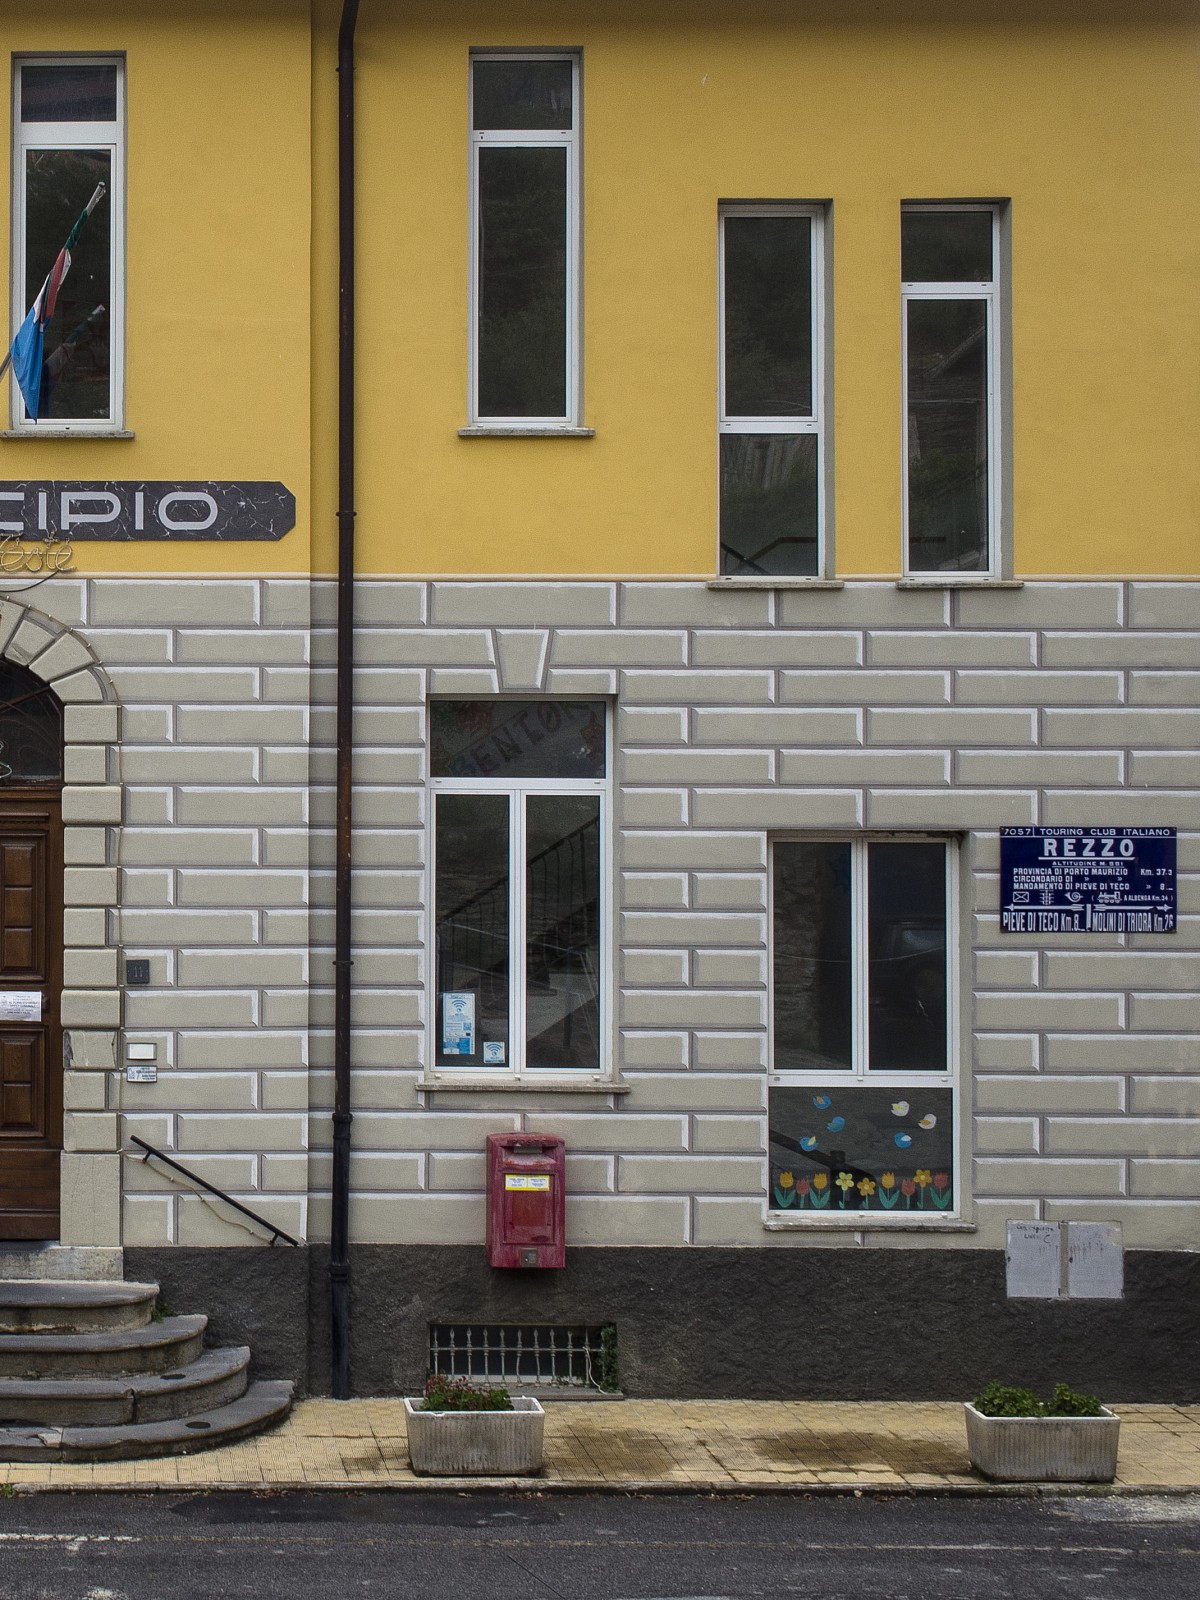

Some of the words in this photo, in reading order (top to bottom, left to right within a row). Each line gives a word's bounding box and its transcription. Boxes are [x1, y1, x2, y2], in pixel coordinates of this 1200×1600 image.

[1004, 828, 1032, 836] 7057
[1040, 828, 1084, 836] TOURING
[1090, 828, 1116, 836] CLUB
[1123, 828, 1170, 836] ITALIANO
[1043, 838, 1134, 857] REZZO
[1013, 867, 1052, 875] PROVINCIA
[1091, 868, 1128, 876] MAURIZIO
[1140, 868, 1154, 876] Km.
[1013, 875, 1063, 883] CIRCONDARIO
[1002, 911, 1026, 931] PIEVE
[1027, 912, 1036, 931] DI
[1038, 912, 1059, 931] TECO
[1092, 912, 1116, 931] MOLINI
[1118, 912, 1126, 931] DI
[1127, 912, 1152, 931] TRIORA
